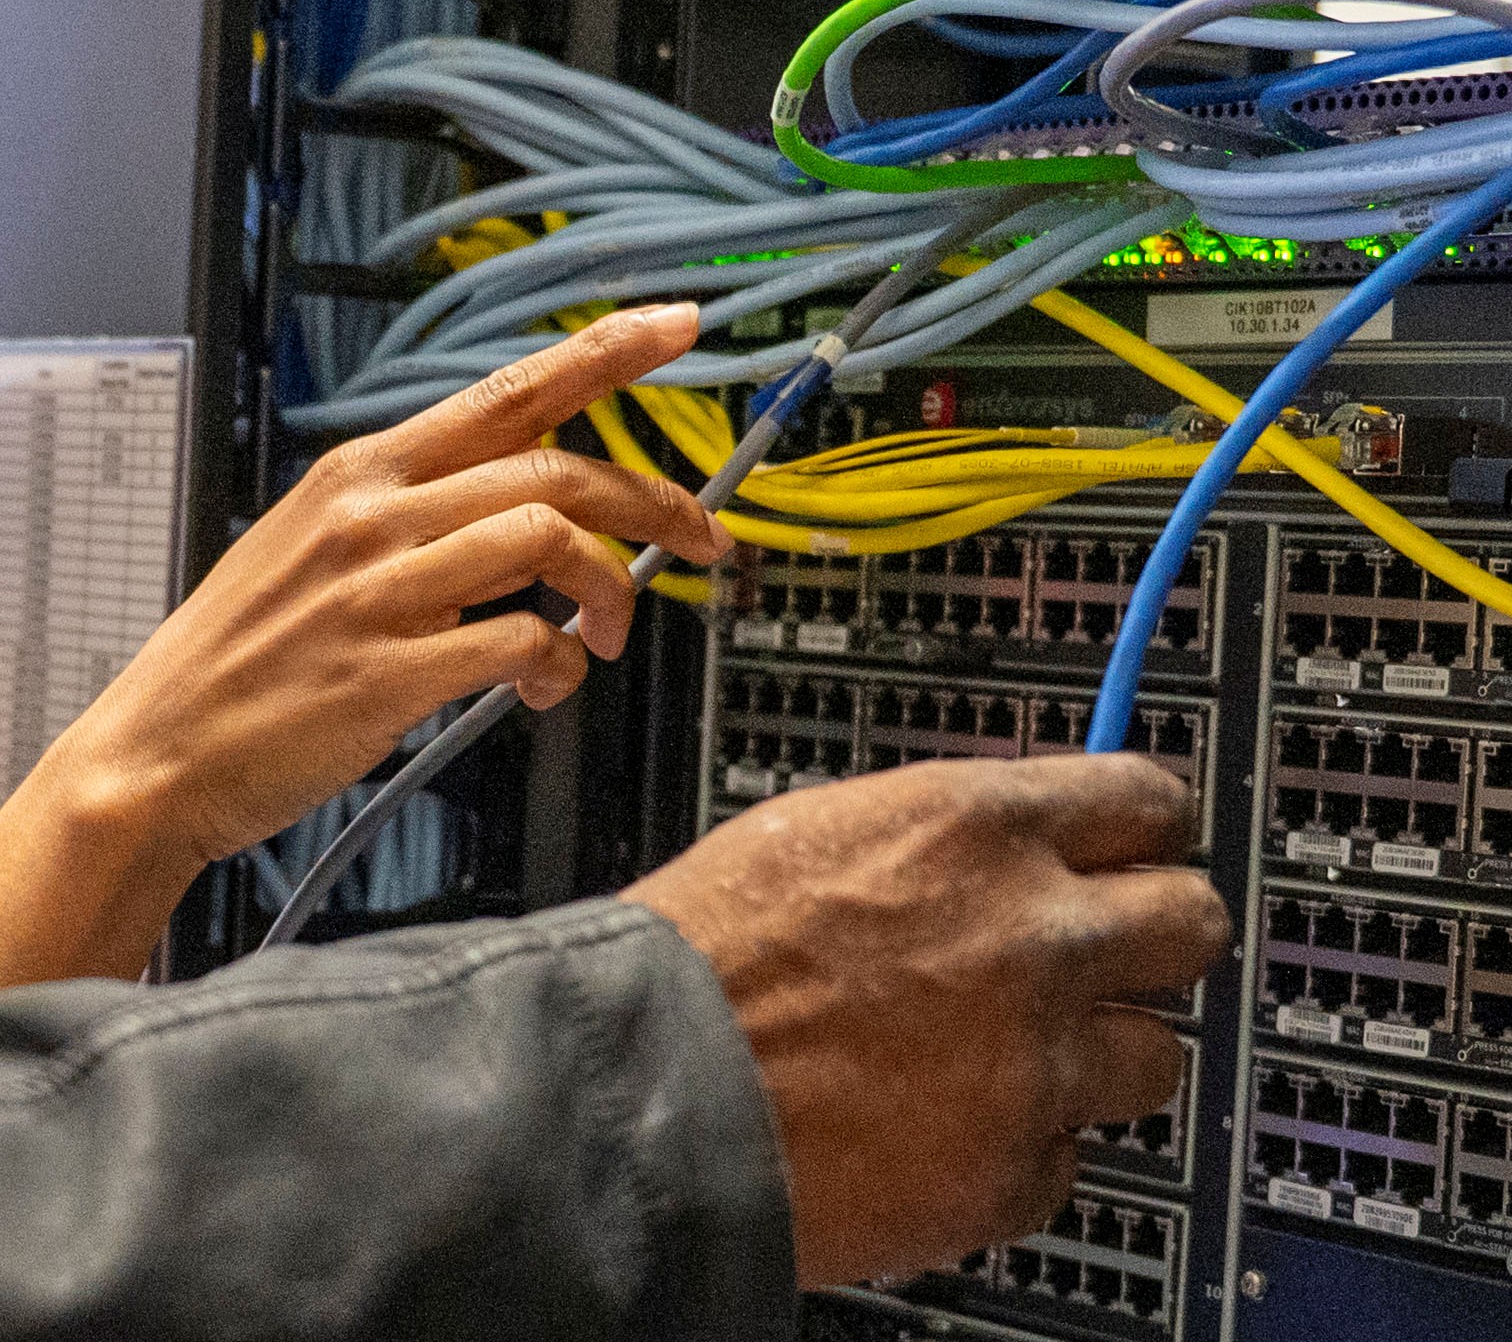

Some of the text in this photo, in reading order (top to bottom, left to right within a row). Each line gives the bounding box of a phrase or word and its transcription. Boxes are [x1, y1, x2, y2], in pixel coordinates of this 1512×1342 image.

[1229, 318, 1299, 334] 10.30.1.34
[1252, 602, 1264, 616] 2
[1232, 945, 1244, 959] 6
[1204, 1282, 1223, 1300] 10
